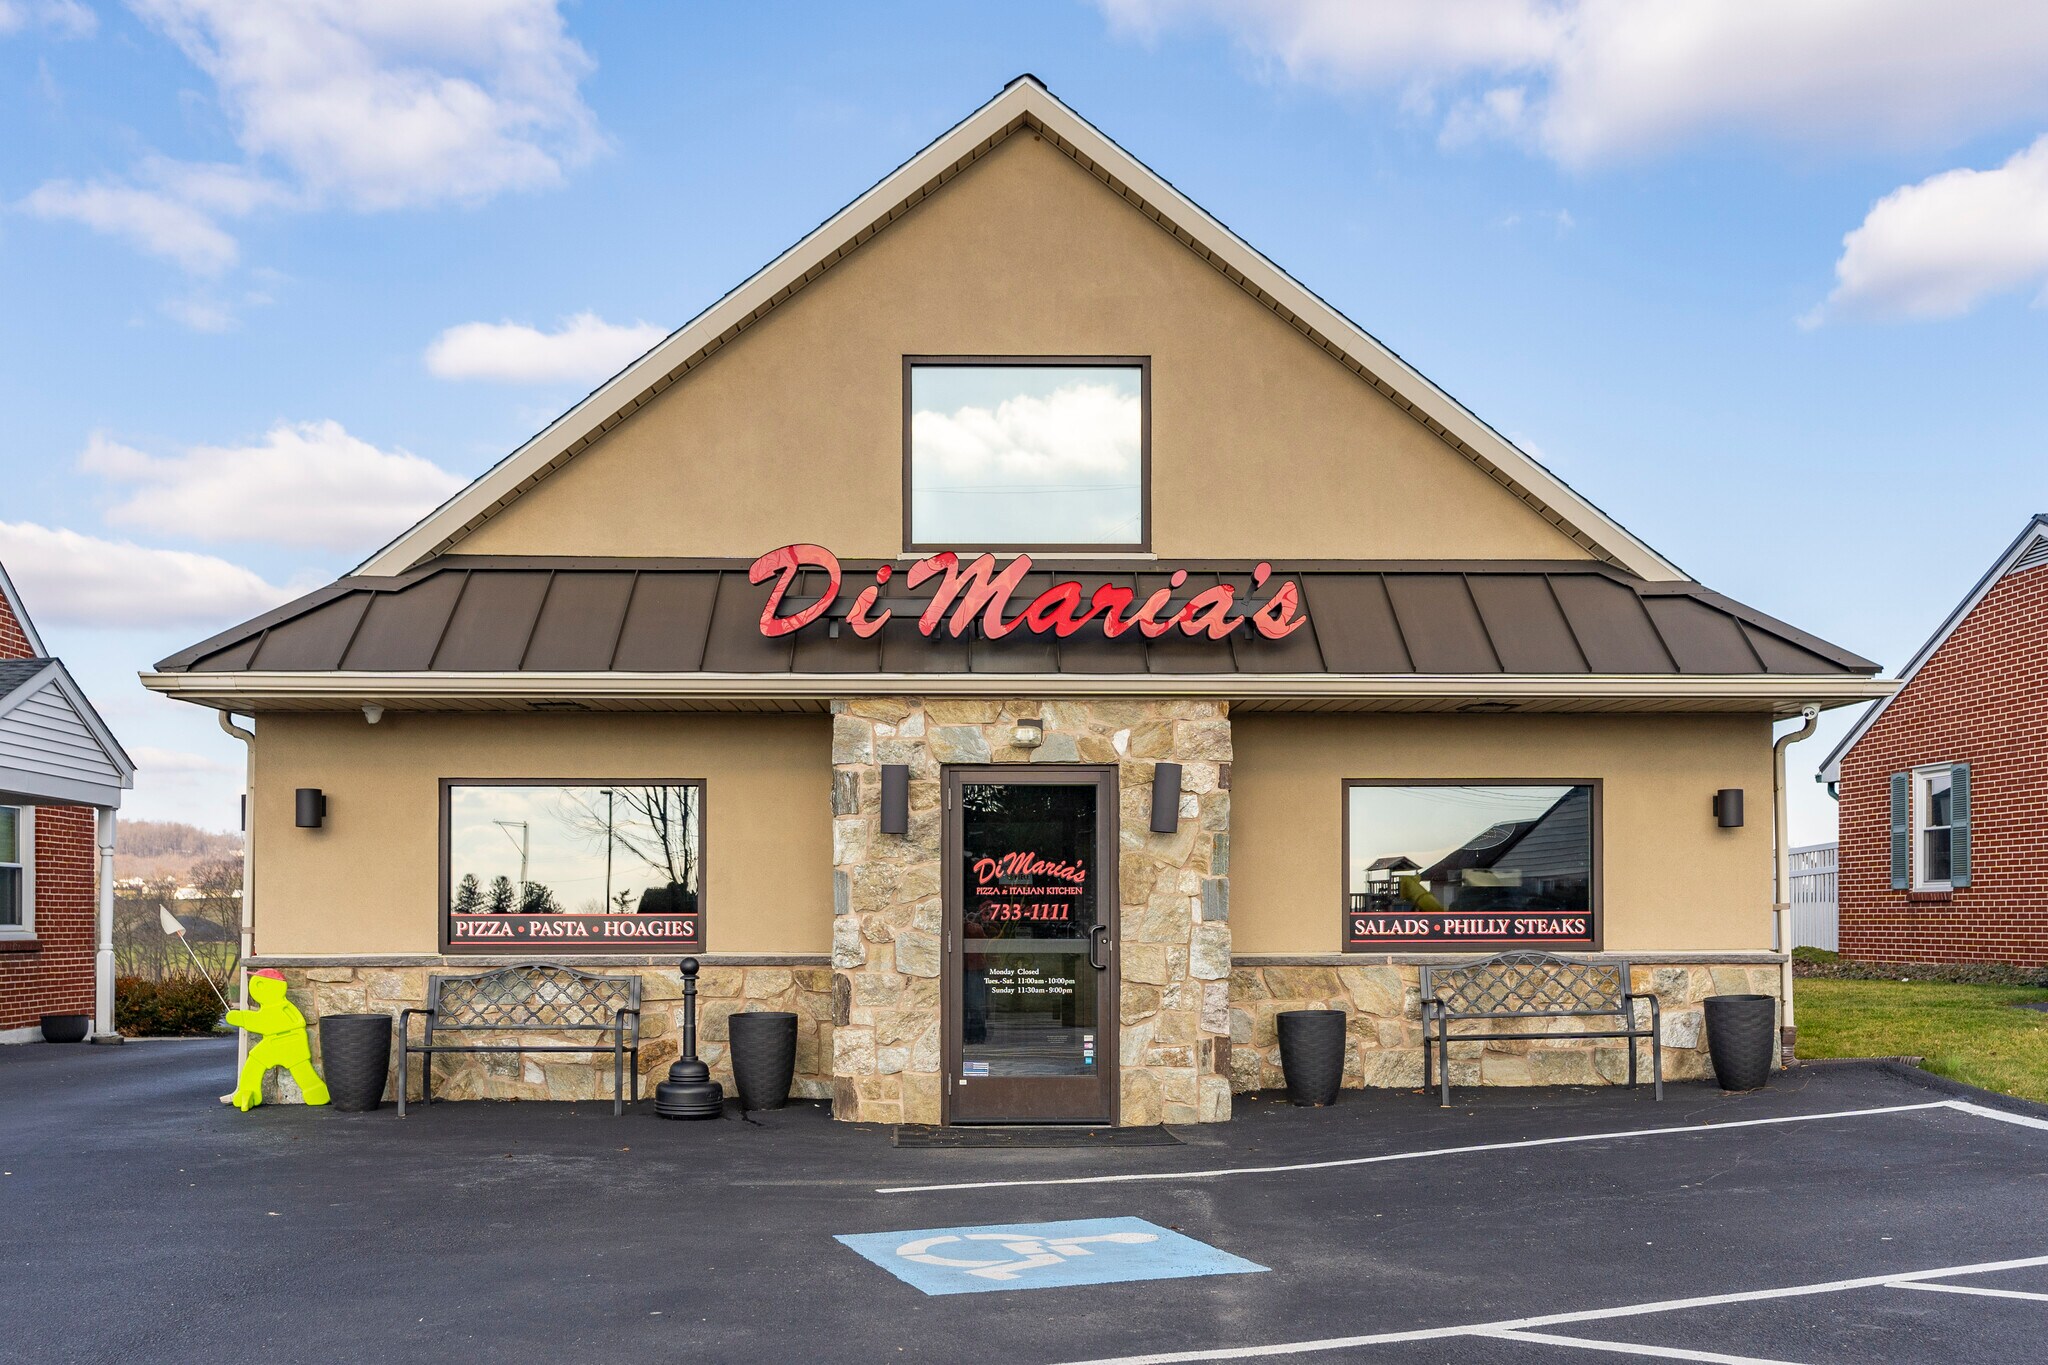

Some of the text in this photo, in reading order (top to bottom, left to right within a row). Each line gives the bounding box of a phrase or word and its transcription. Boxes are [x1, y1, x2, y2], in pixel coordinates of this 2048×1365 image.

[976, 886, 1000, 896] PIZZA
[1009, 886, 1045, 896] ITALIAN
[1046, 886, 1083, 895] KITCHEN
[990, 903, 1069, 920] 733-1111
[455, 920, 695, 937] PIZZA PASTA HOAGIES
[1354, 918, 1586, 936] SALADS PHILLY STEAKS
[989, 968, 1015, 976] Monday
[991, 986, 1015, 995] Sunday
